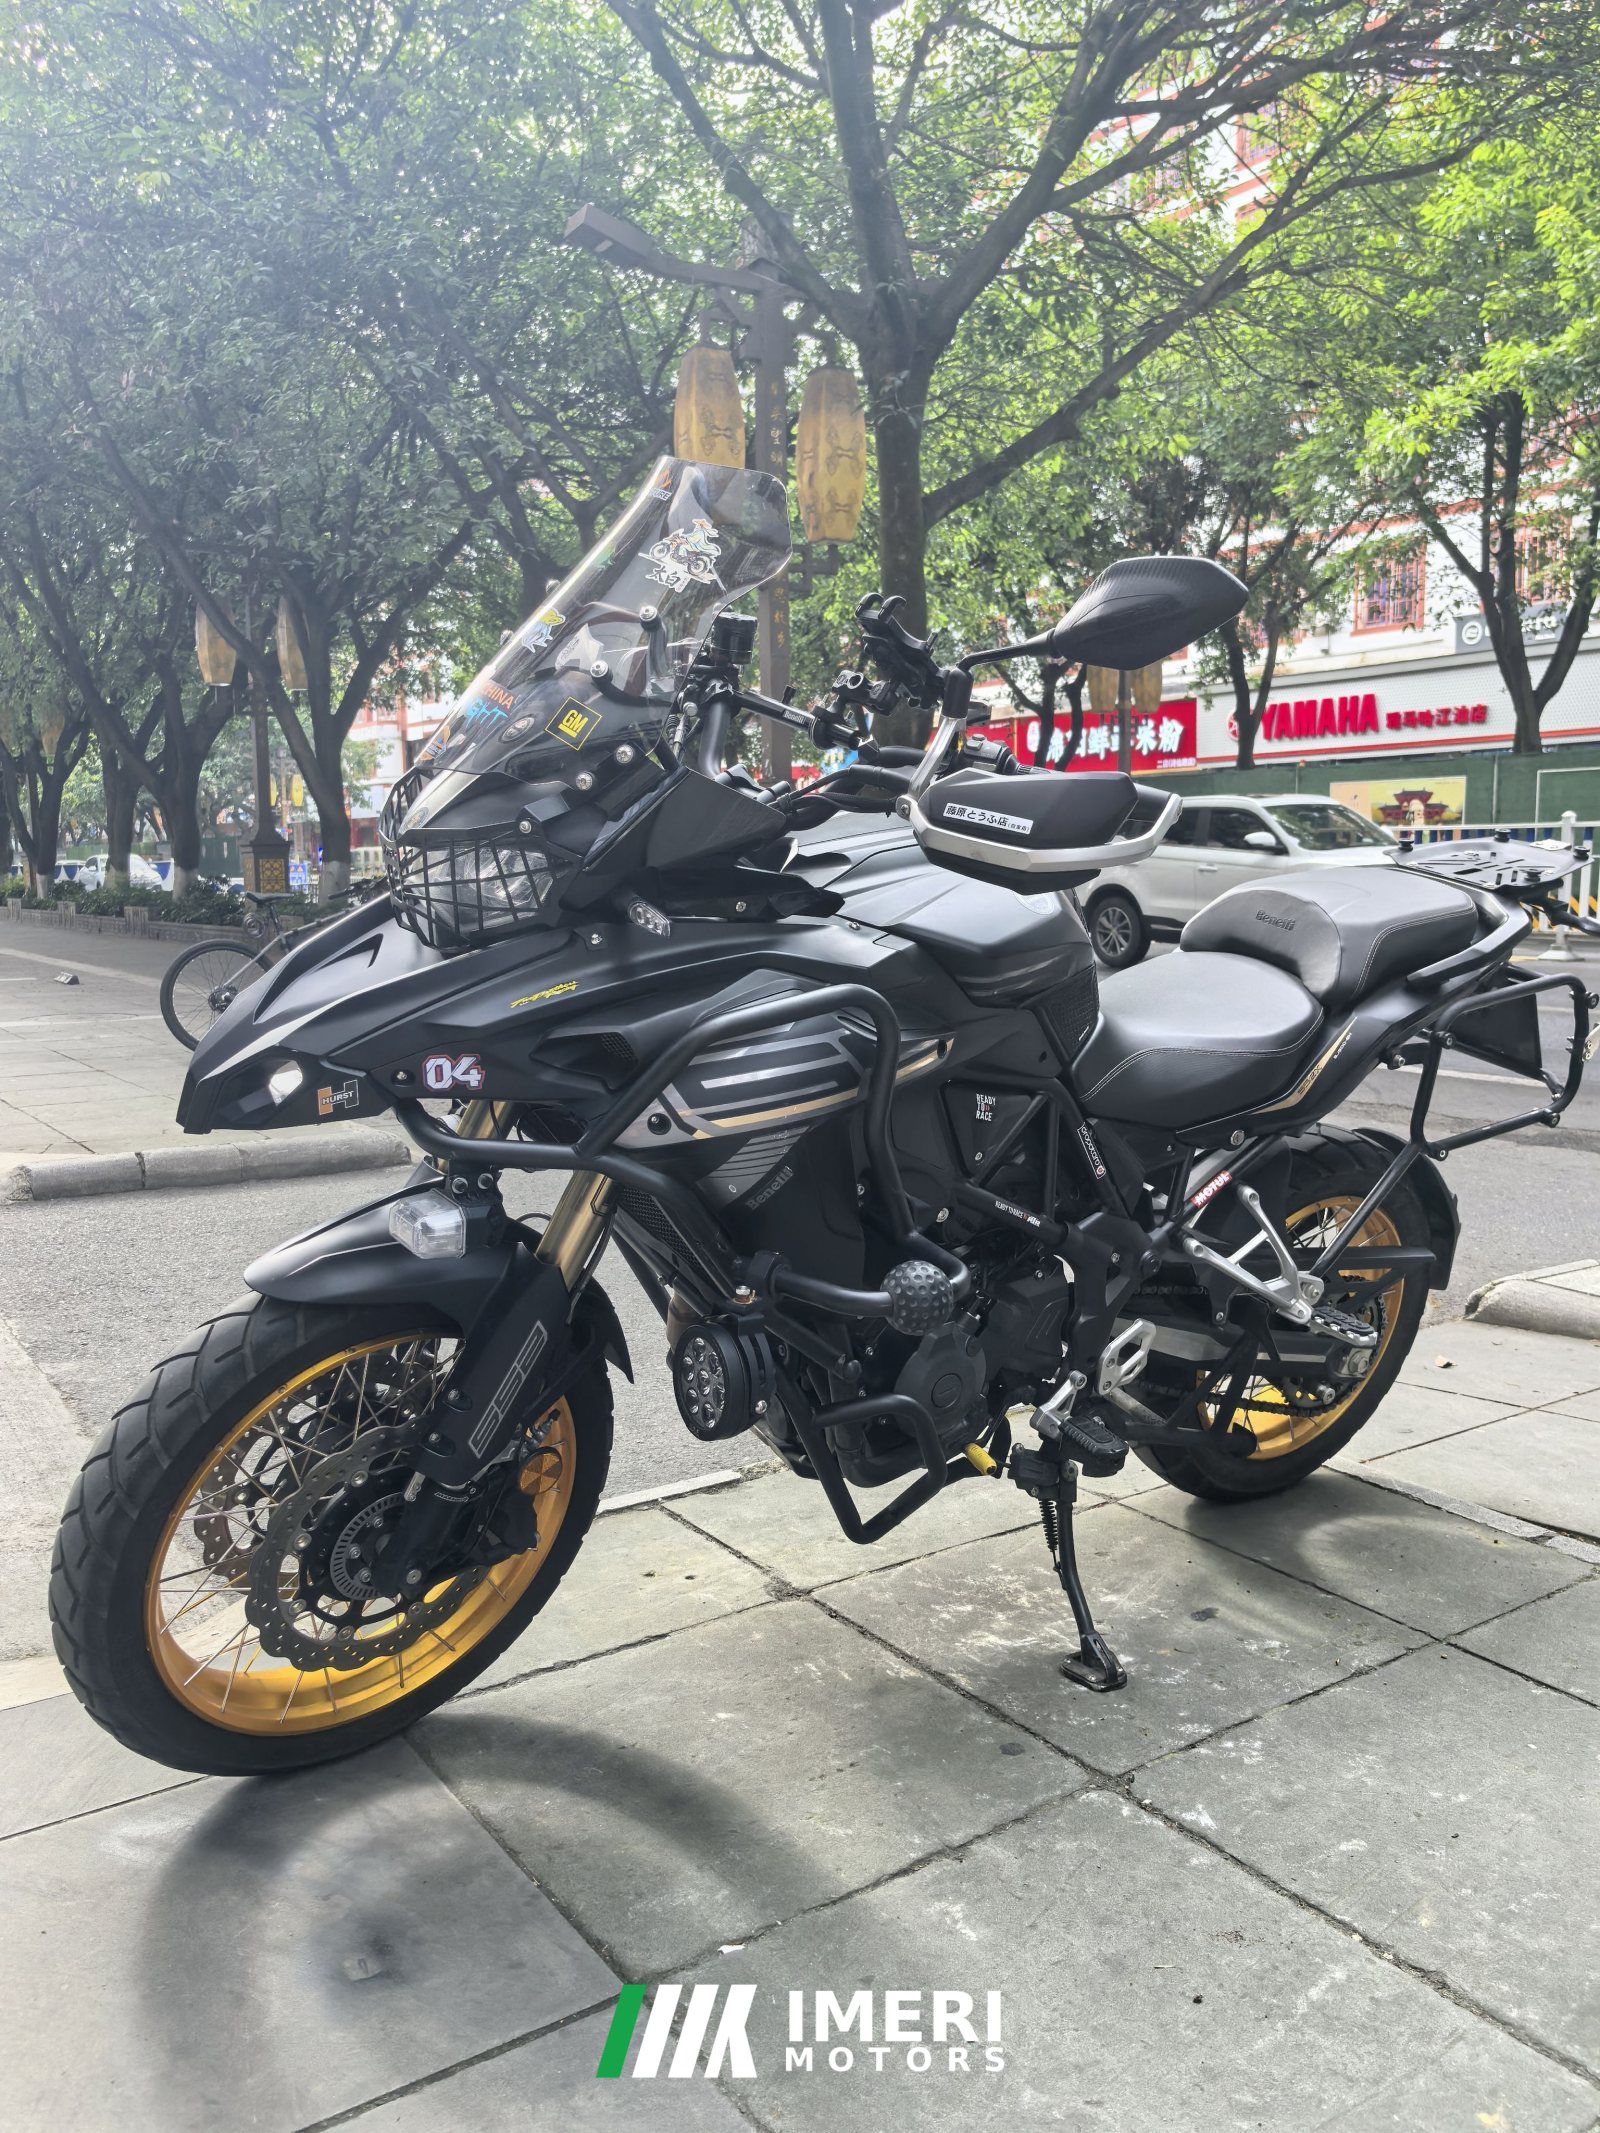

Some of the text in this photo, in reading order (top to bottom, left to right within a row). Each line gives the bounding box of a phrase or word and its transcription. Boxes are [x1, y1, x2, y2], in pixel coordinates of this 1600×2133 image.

[651, 565, 679, 587] 太白
[562, 709, 589, 733] GM
[1260, 693, 1379, 741] YAMAHA
[1255, 909, 1296, 931] Benelli
[423, 1054, 485, 1091] 04
[322, 1090, 355, 1105] HURST
[976, 1093, 996, 1106] READY
[977, 1103, 985, 1112] TO
[976, 1110, 993, 1122] RACE
[744, 1165, 794, 1211] Benelli
[1194, 1171, 1230, 1206] MOTUL
